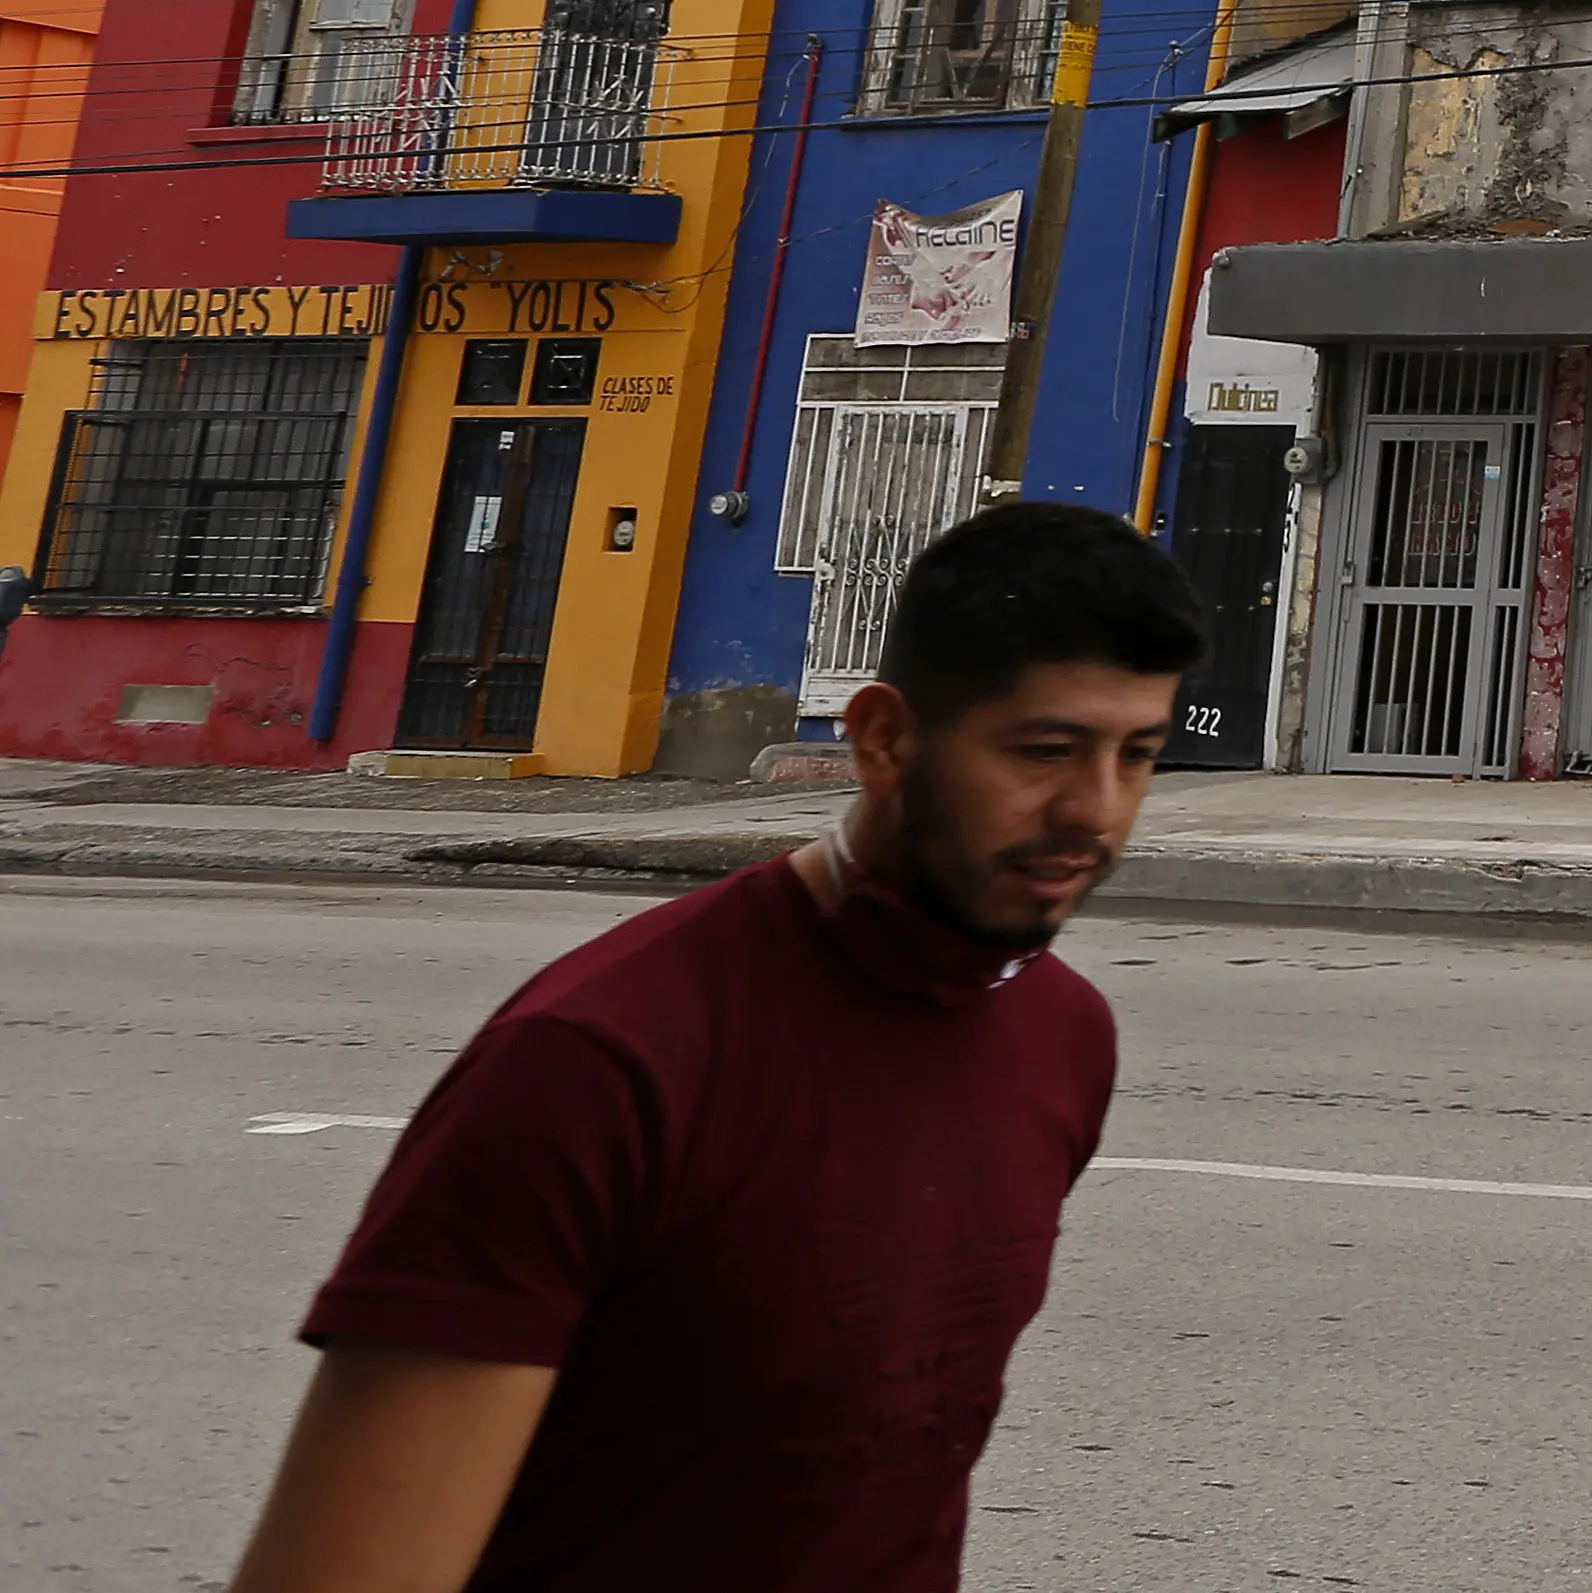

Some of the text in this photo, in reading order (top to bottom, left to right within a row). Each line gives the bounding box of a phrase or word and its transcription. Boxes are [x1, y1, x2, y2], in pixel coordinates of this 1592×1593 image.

[54, 286, 270, 339] ESTAMBRES
[288, 286, 310, 336] Y
[603, 376, 674, 395] CLASES DE
[599, 395, 651, 413] TEJIDO
[1185, 704, 1222, 738] 222
